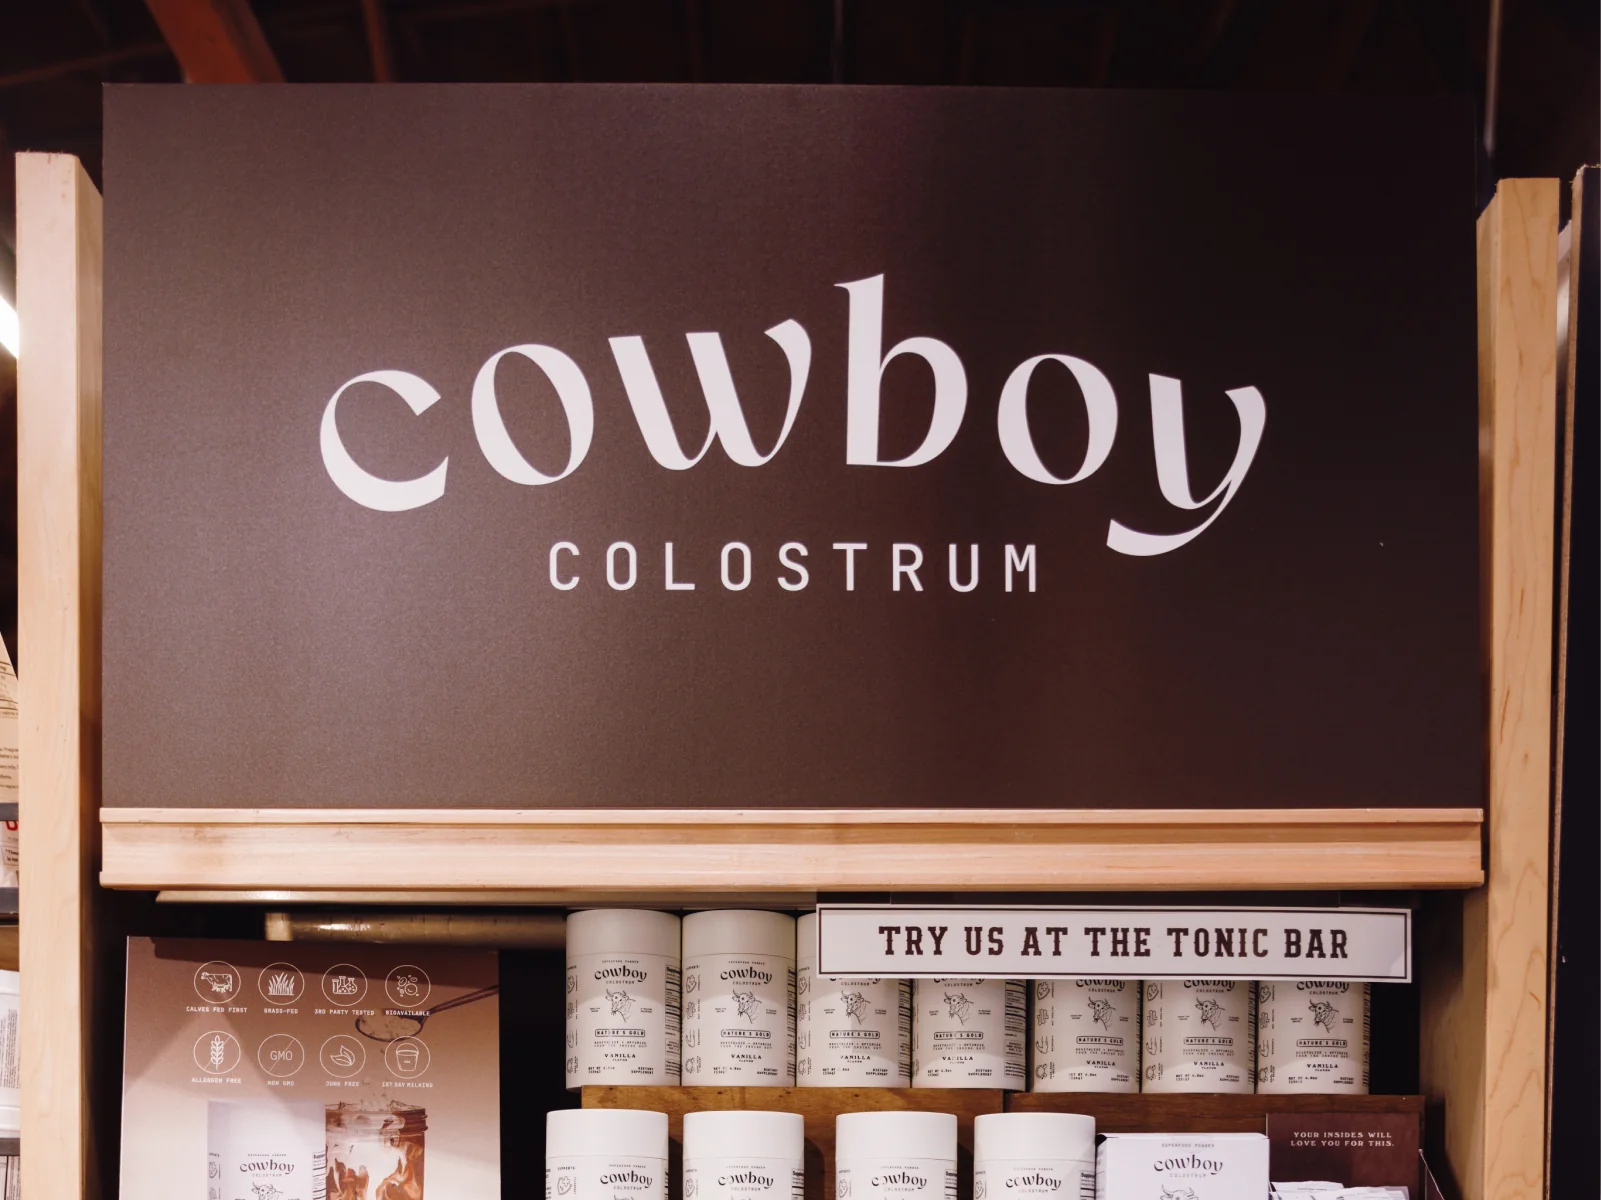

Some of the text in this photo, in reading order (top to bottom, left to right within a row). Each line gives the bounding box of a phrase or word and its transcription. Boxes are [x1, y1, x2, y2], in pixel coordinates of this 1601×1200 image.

[319, 273, 1266, 556] cowboy
[548, 540, 1036, 593] COLOSTRUM
[879, 926, 1347, 958] TRY US AT THE TONIC BAR
[595, 966, 647, 982] cowboy
[721, 967, 772, 984] cowboy
[270, 1052, 292, 1061] GMO
[240, 1160, 294, 1174] cowboy
[1154, 1155, 1223, 1175] cowboy
[600, 1171, 652, 1188] cowboy
